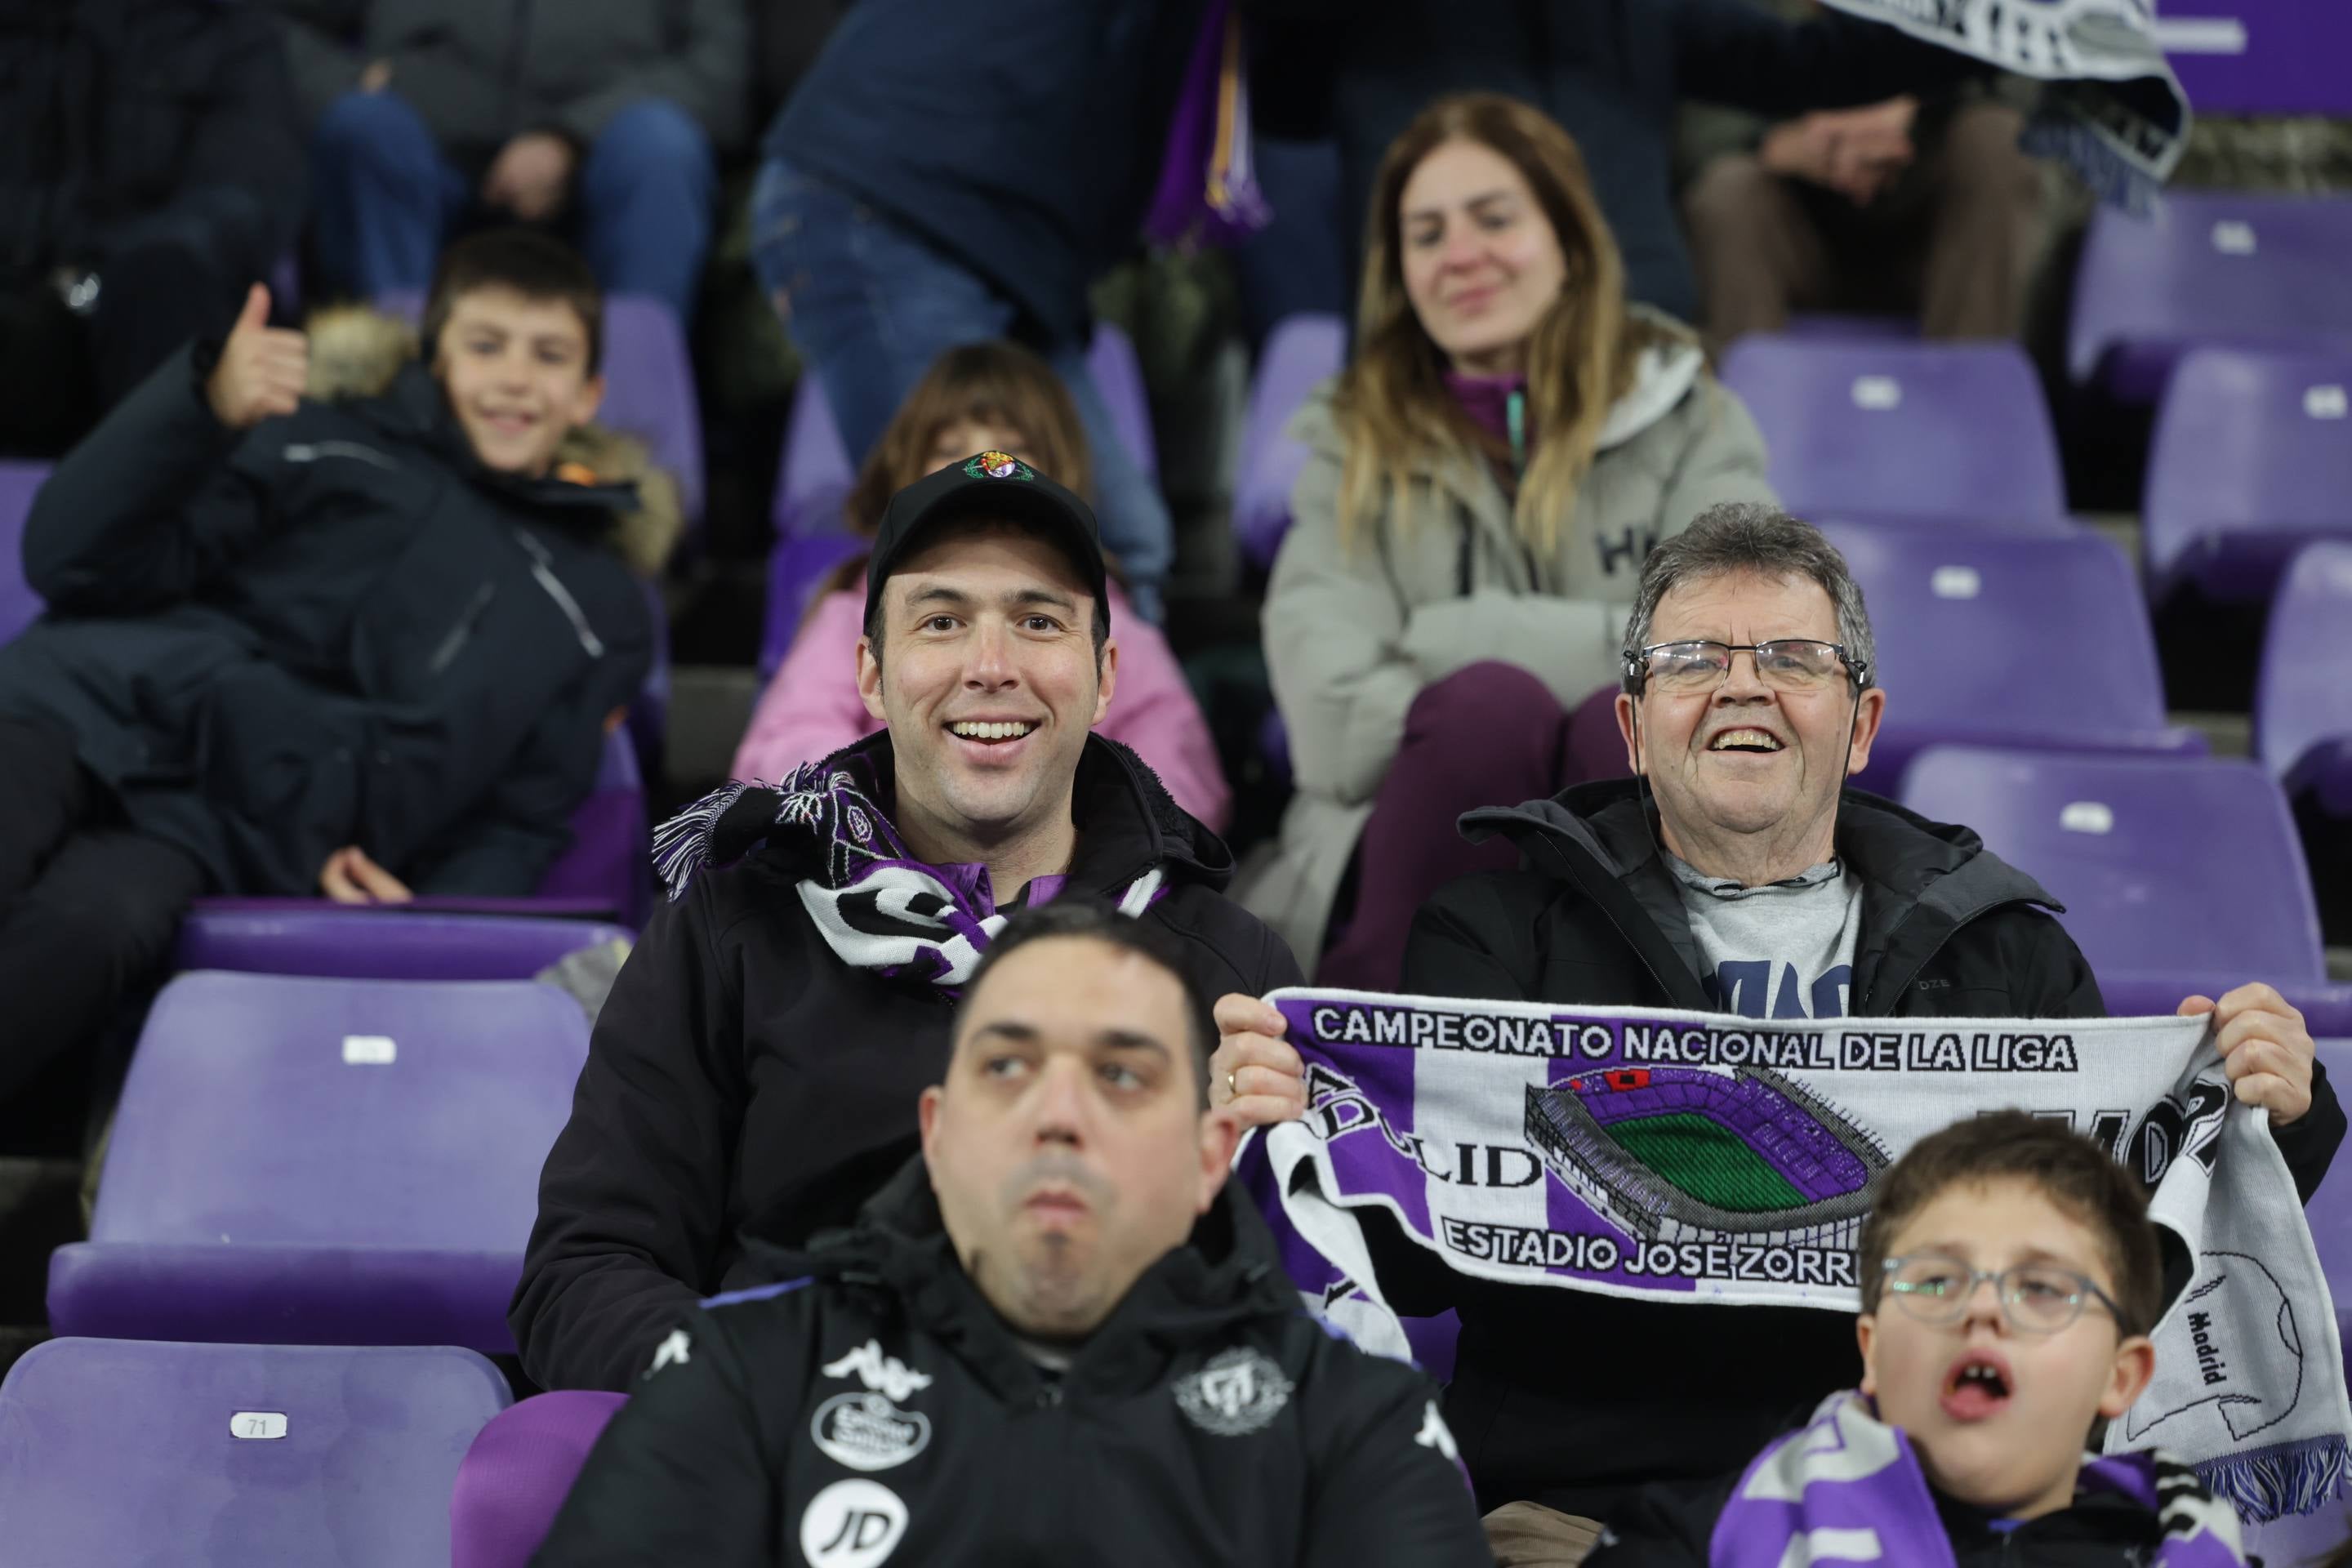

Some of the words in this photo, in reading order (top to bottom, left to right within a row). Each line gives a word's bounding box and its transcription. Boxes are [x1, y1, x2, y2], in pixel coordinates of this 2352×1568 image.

[1312, 1007, 1614, 1059] CAMPEONATO
[1624, 1026, 1835, 1070] NACIONAL
[1841, 1032, 1901, 1070] DE
[1908, 1033, 1965, 1071] LA
[1971, 1033, 2078, 1071] LIGA
[1444, 1220, 1619, 1271] ESTADIO
[1624, 1240, 1731, 1279] JOSE
[2187, 1310, 2228, 1386] Madrid
[248, 1419, 267, 1436] 71
[819, 1509, 892, 1553] JD
